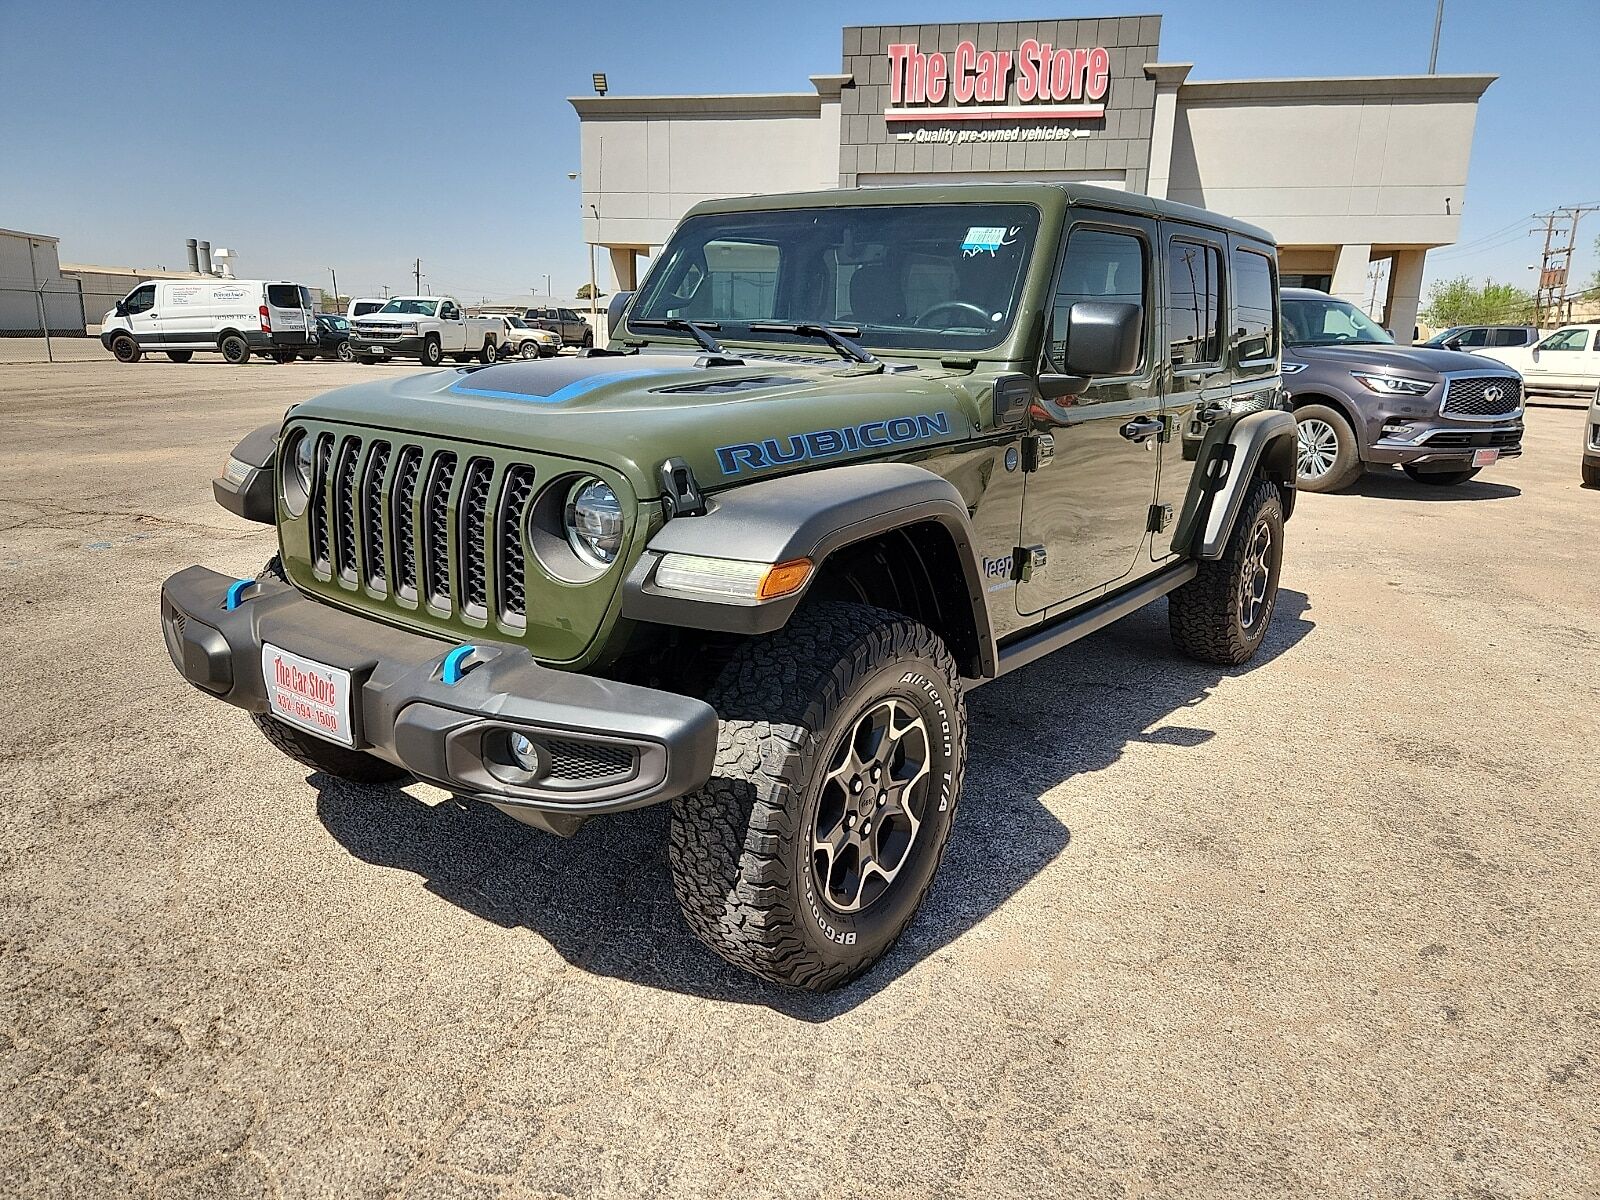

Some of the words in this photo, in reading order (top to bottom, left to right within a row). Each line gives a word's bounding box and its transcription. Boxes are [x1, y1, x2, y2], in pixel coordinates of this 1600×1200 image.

[888, 43, 948, 104] The
[953, 40, 1013, 104] Car
[1016, 38, 1110, 103] Store
[915, 128, 957, 145] Quality
[957, 126, 1019, 144] pre-owned
[1021, 126, 1071, 141] vehicles
[715, 411, 950, 475] RUBICON
[982, 555, 1014, 579] Jeep
[274, 656, 291, 689] The
[290, 665, 307, 695] Car
[308, 671, 336, 706] Store
[898, 671, 953, 758] All-Terrain
[938, 769, 953, 812] T/A
